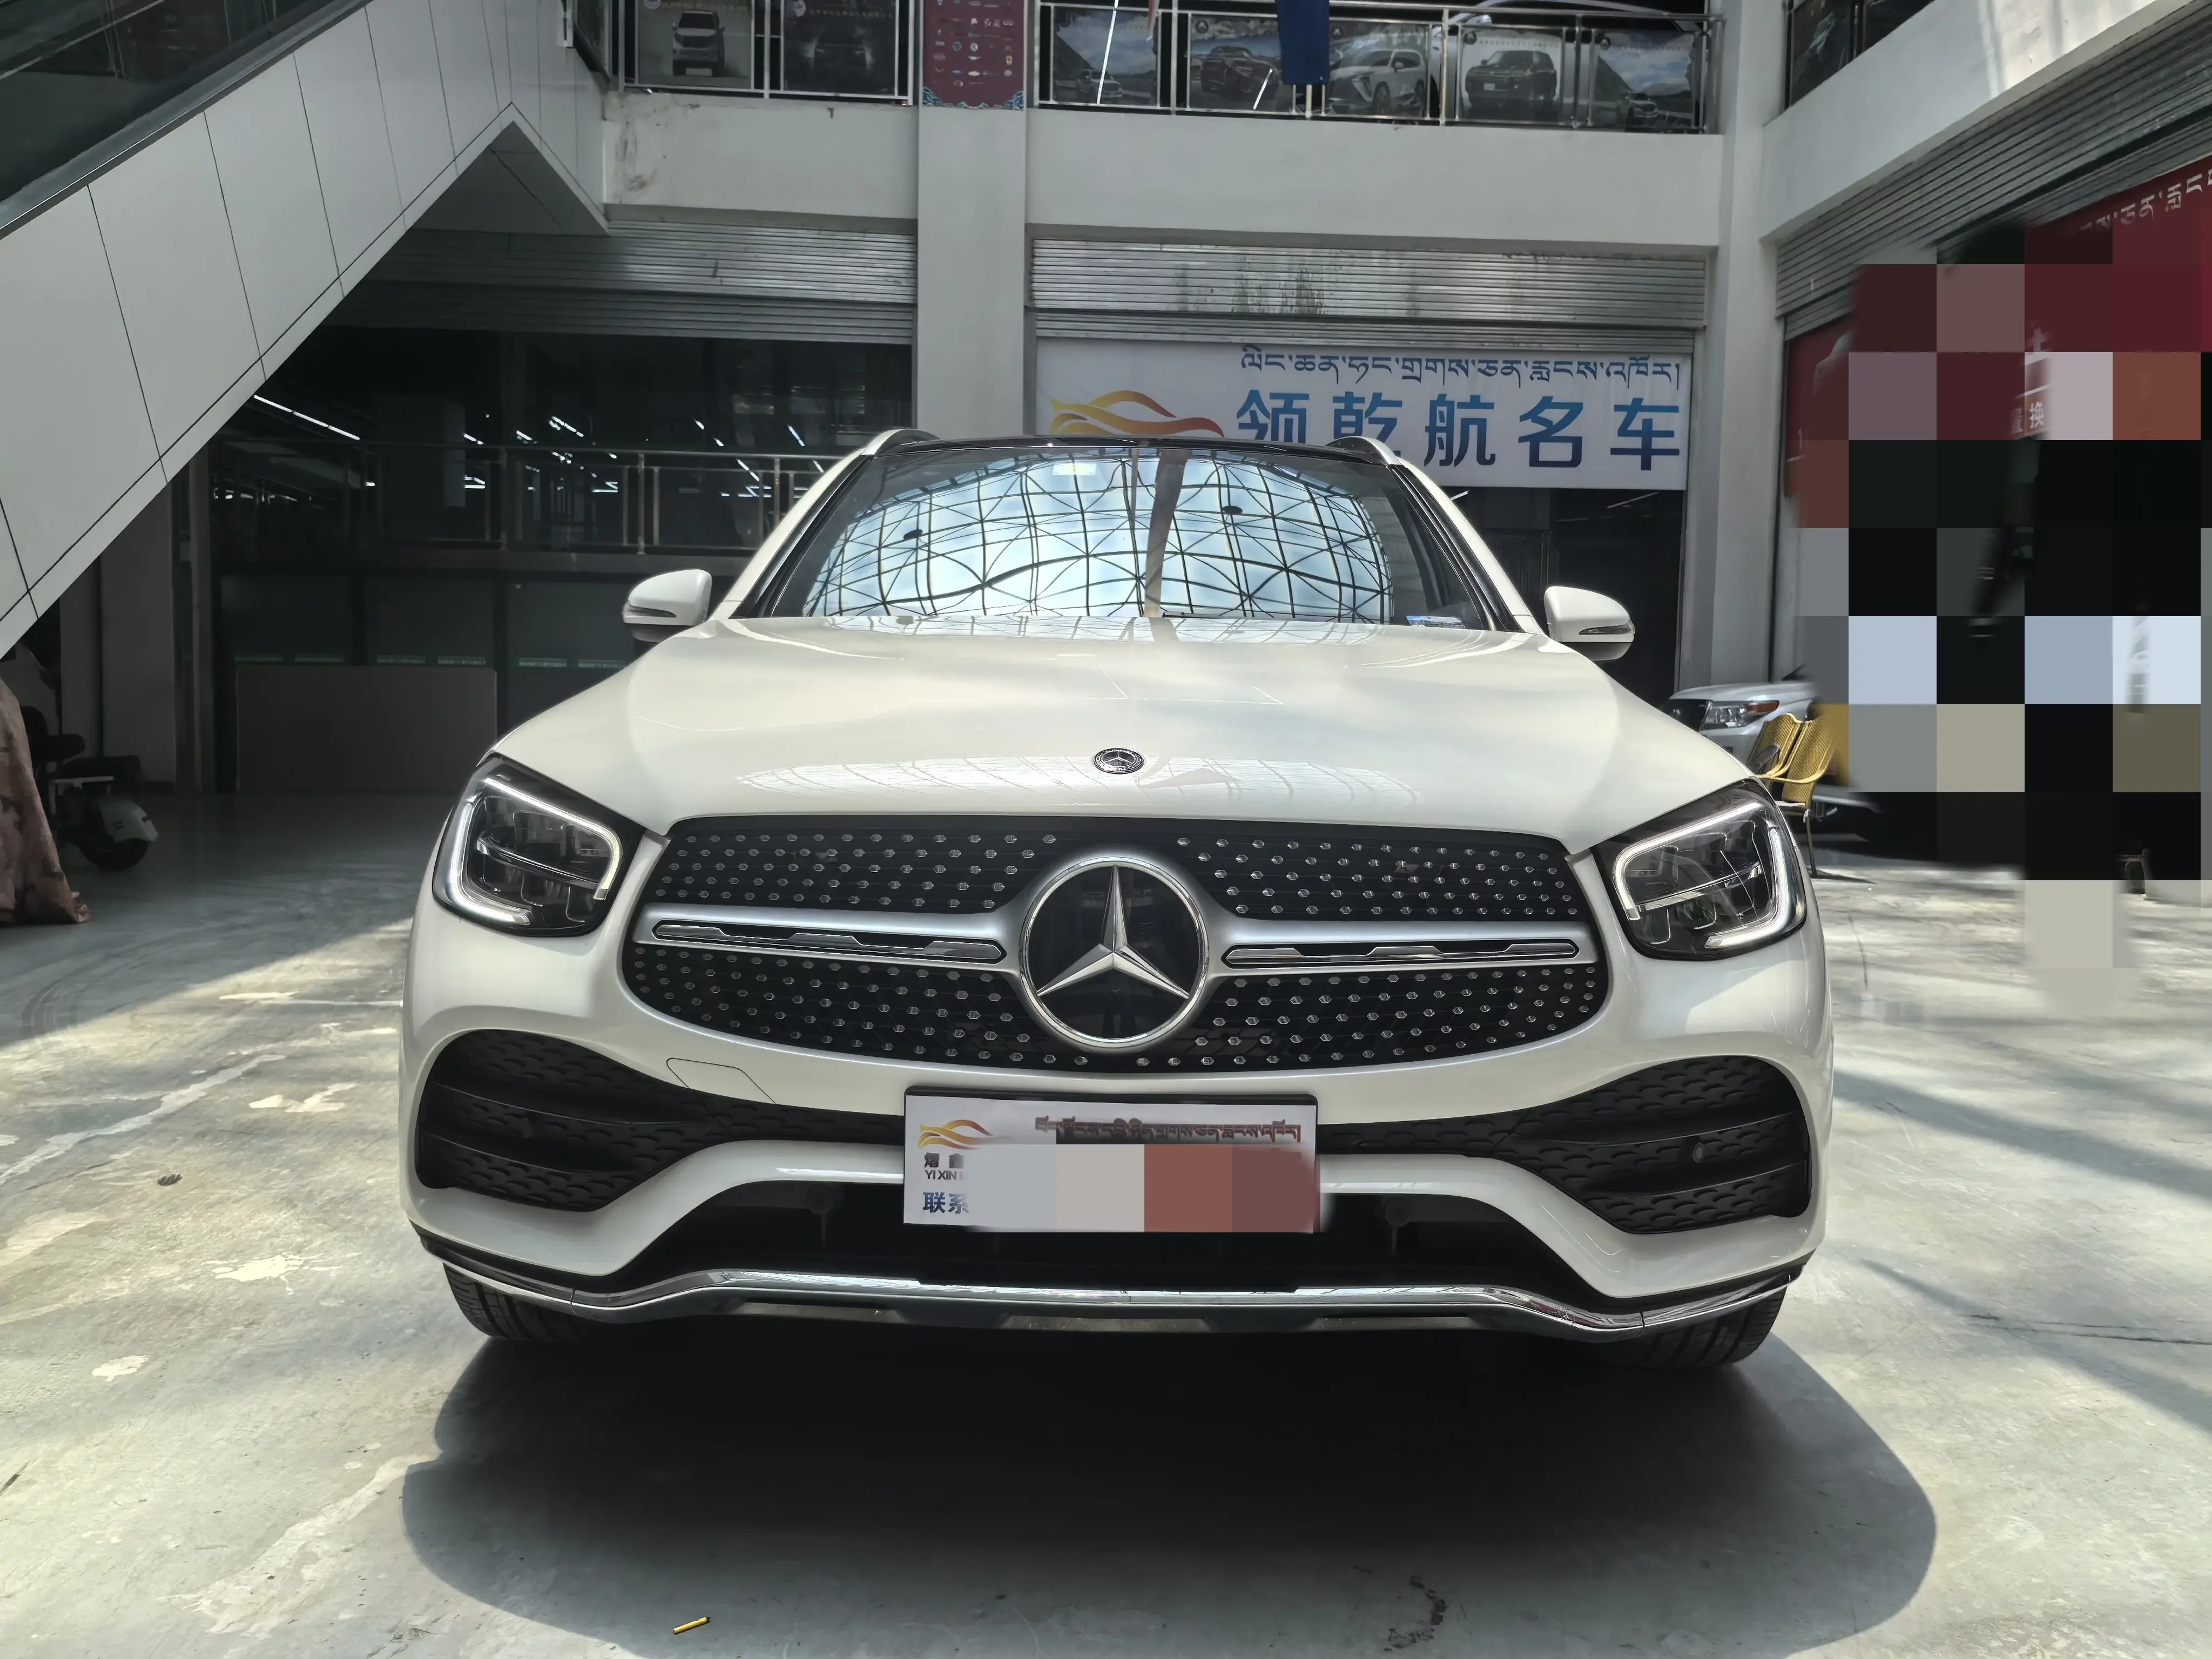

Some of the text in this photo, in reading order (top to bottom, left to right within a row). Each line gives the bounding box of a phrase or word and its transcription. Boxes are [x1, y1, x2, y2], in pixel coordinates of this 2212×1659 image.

[1236, 389, 1680, 471] 领乾航名车
